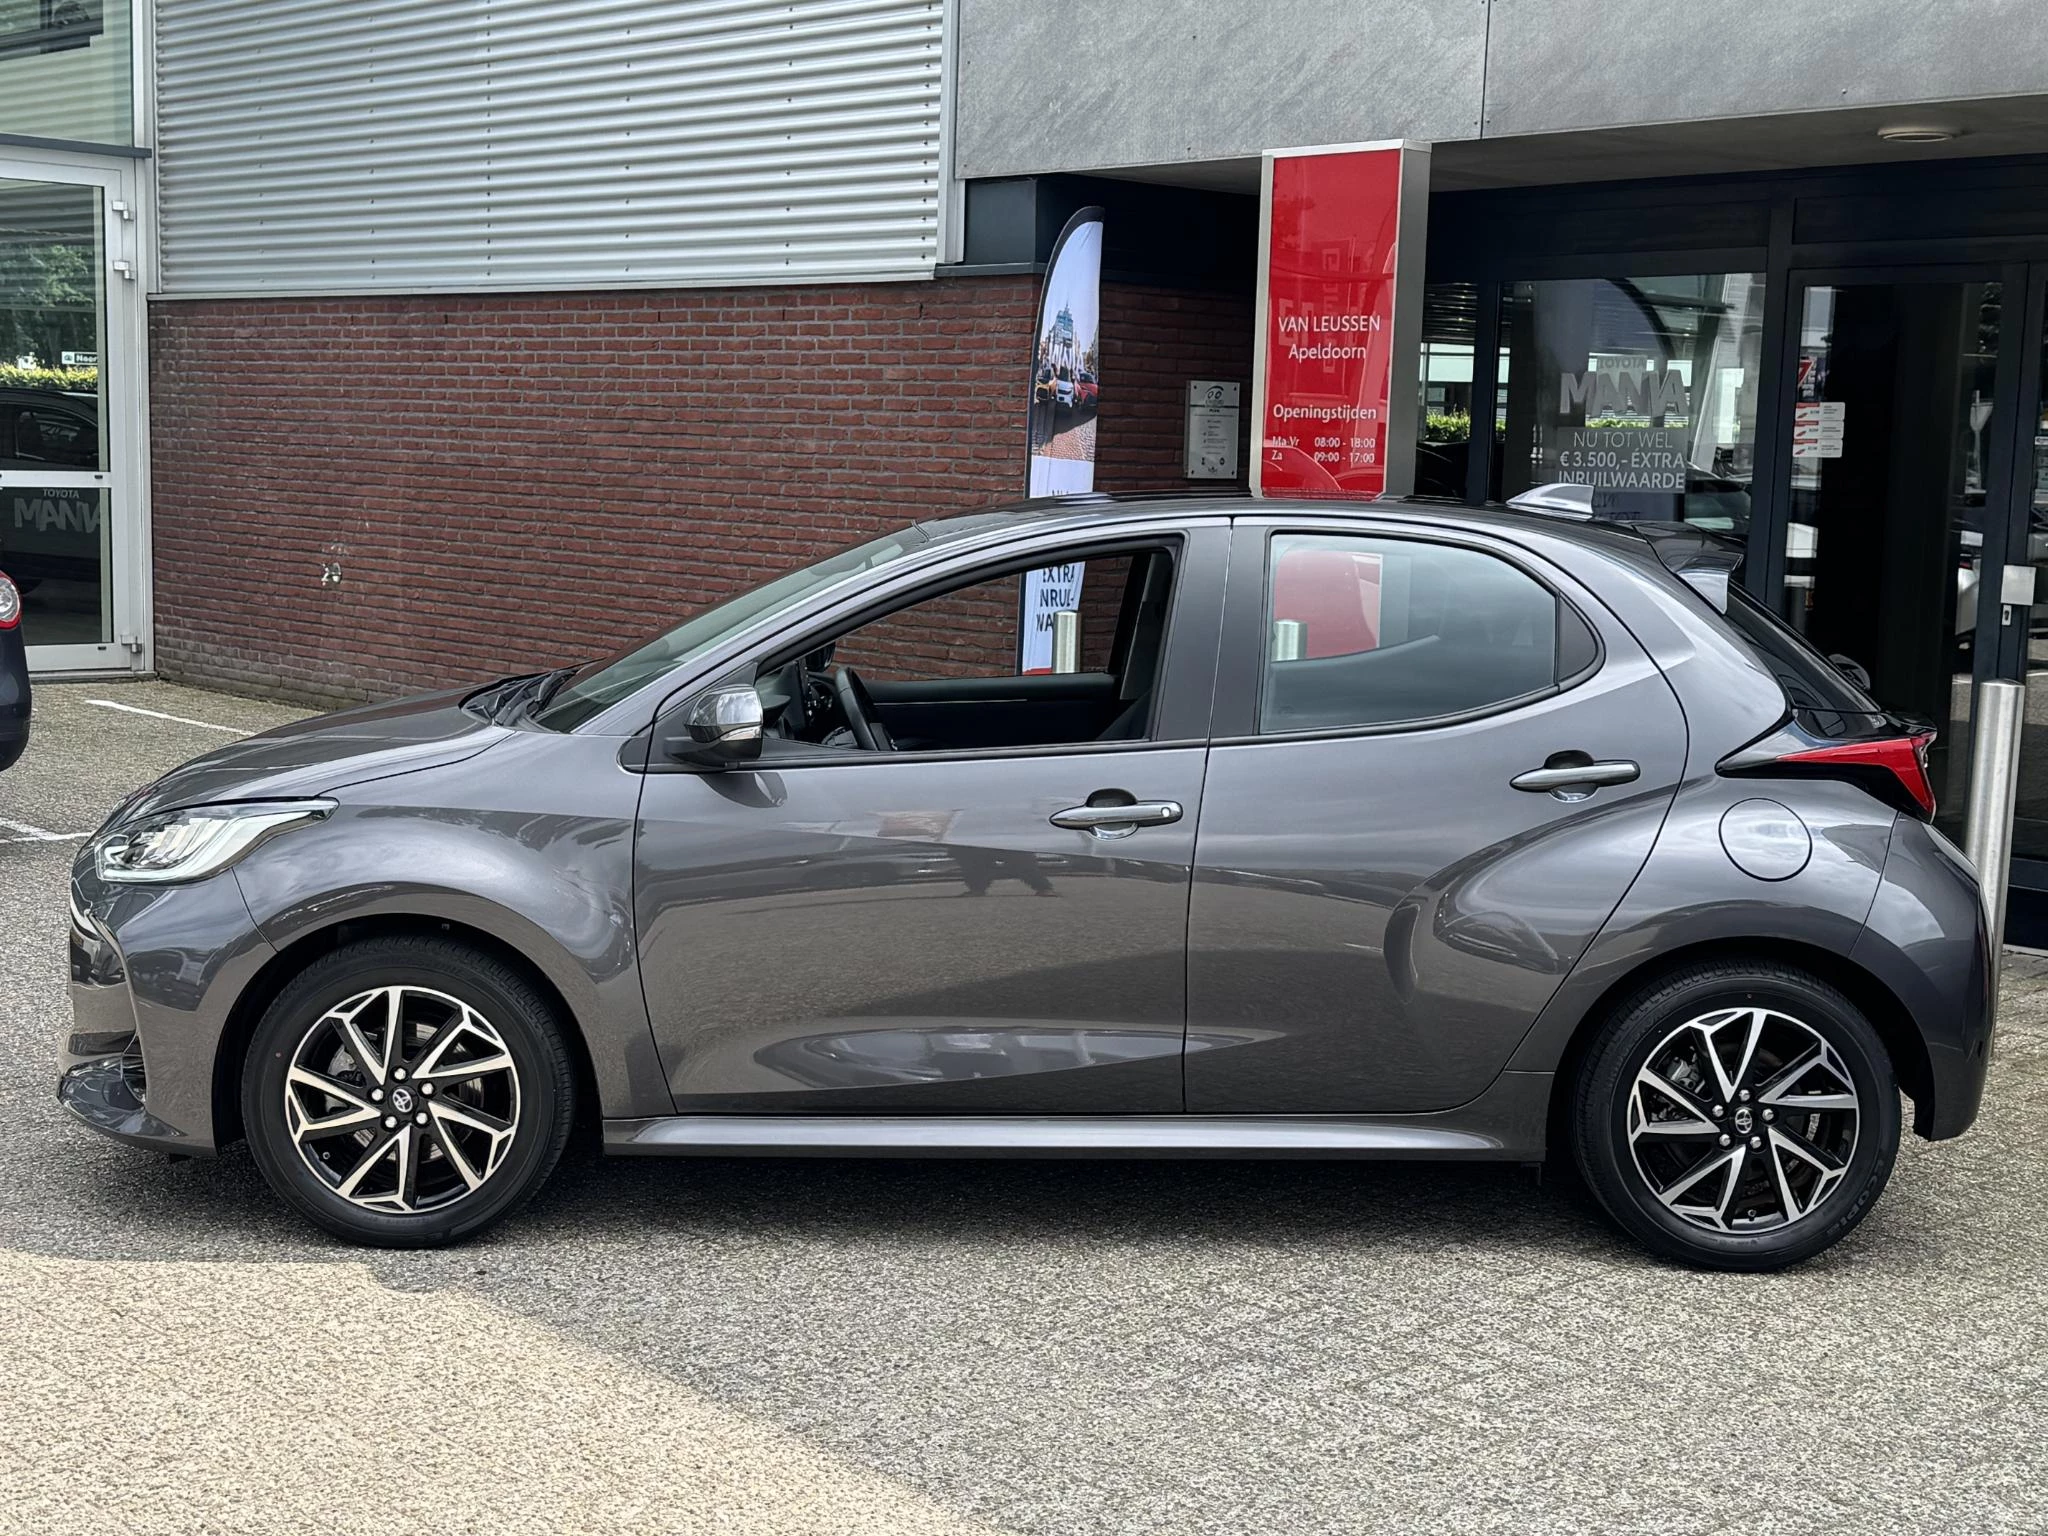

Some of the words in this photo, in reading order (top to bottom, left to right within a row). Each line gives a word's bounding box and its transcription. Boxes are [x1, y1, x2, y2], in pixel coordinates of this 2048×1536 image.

[1278, 316, 1309, 332] VAN
[1313, 315, 1381, 332] LEUSSEN
[1288, 342, 1367, 363] Apeldoorn
[1598, 357, 1647, 369] TOYOTA
[1559, 369, 1690, 418] MANIA
[1273, 403, 1377, 423] Openingstijden
[1314, 437, 1341, 448] 08:00
[1350, 438, 1376, 449] 18:00
[1573, 431, 1598, 448] NU
[1603, 431, 1633, 448] TOT
[1638, 431, 1673, 448] WEL
[1271, 449, 1283, 460] Za
[1313, 451, 1340, 463] 09:00
[1349, 452, 1375, 463] 17:00
[1560, 451, 1570, 467] €
[1573, 451, 1628, 471] 3.500,-
[1558, 470, 1685, 489] INRUILWAARDE
[42, 488, 80, 499] TOYOTA
